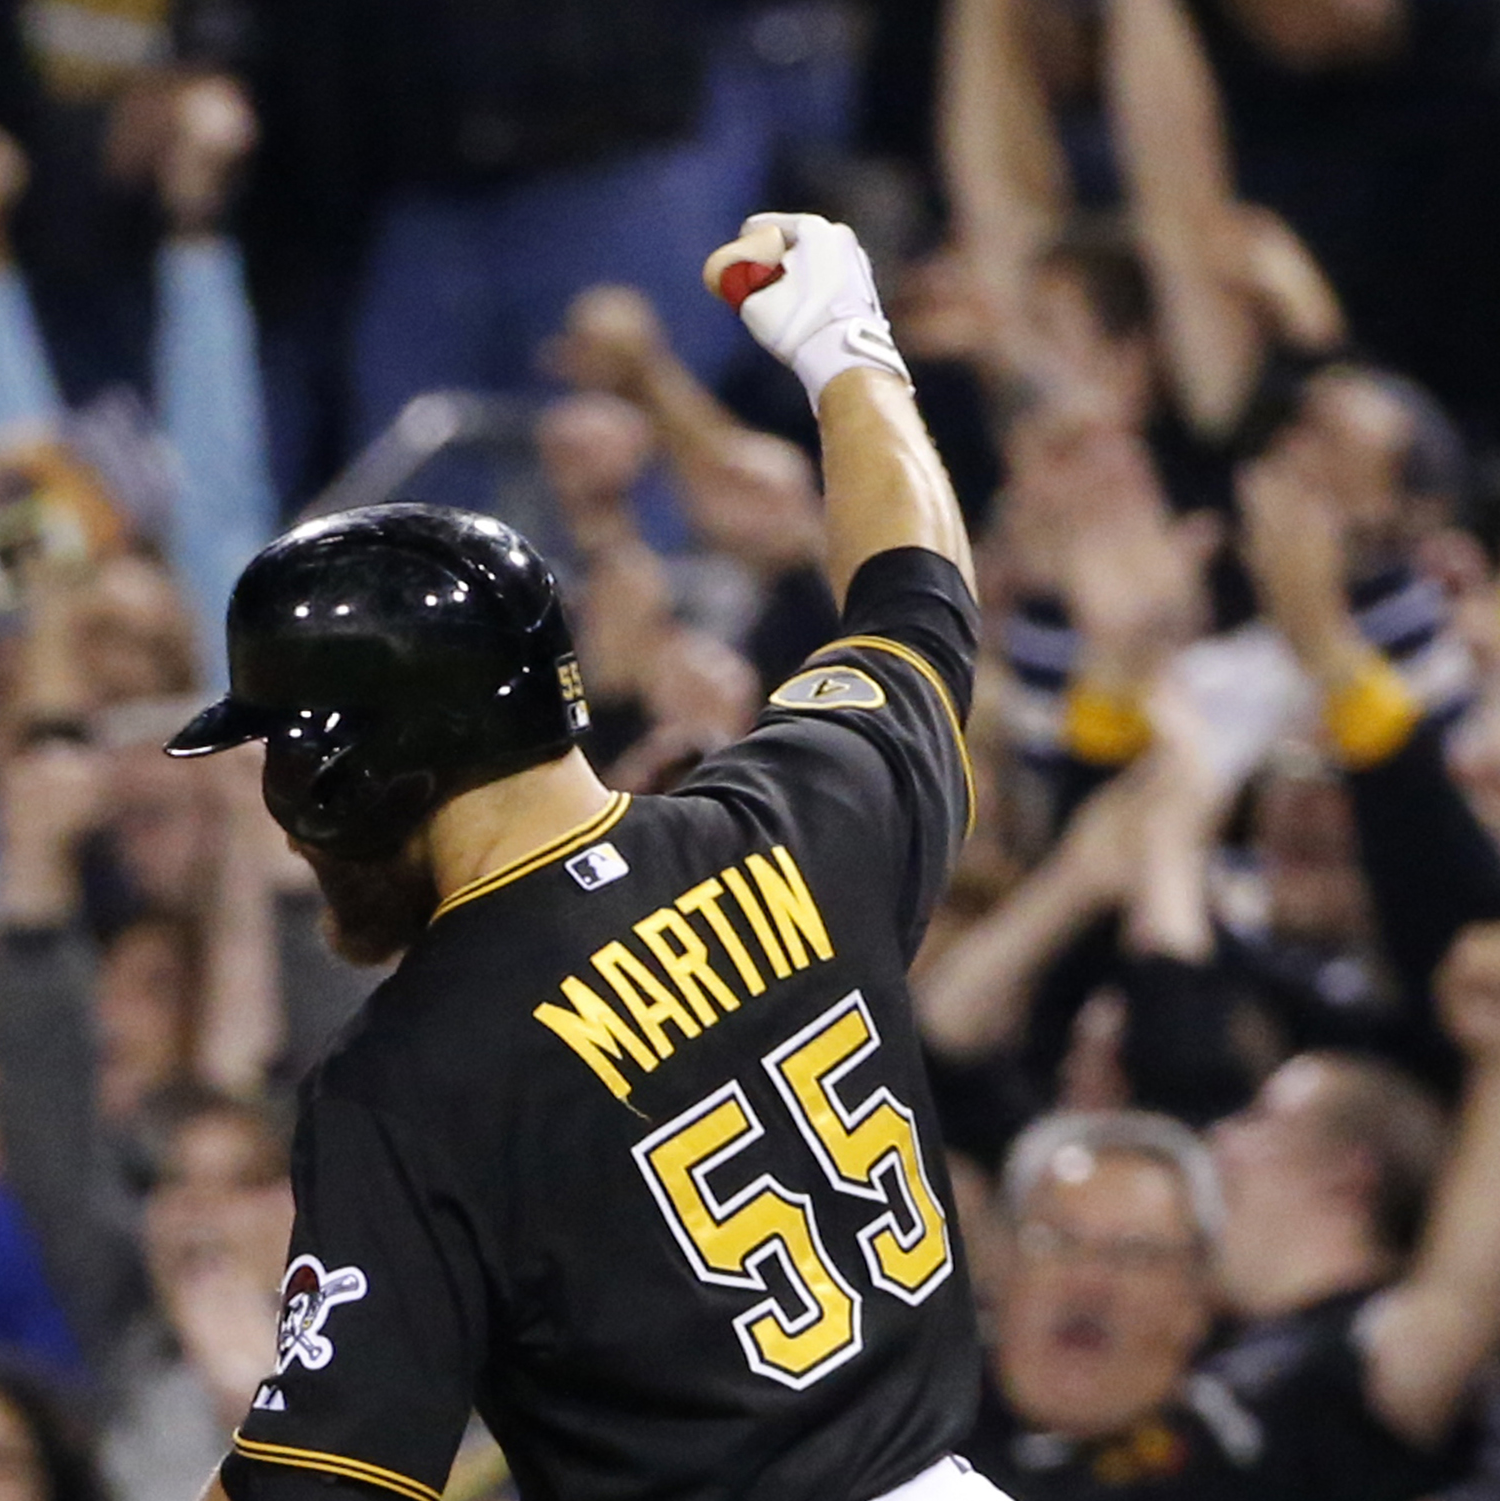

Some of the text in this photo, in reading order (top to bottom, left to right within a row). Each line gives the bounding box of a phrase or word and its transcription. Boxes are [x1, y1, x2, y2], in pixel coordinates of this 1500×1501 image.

[557, 660, 584, 701] 55
[532, 844, 836, 1100] MARTIN
[631, 988, 954, 1391] 55
